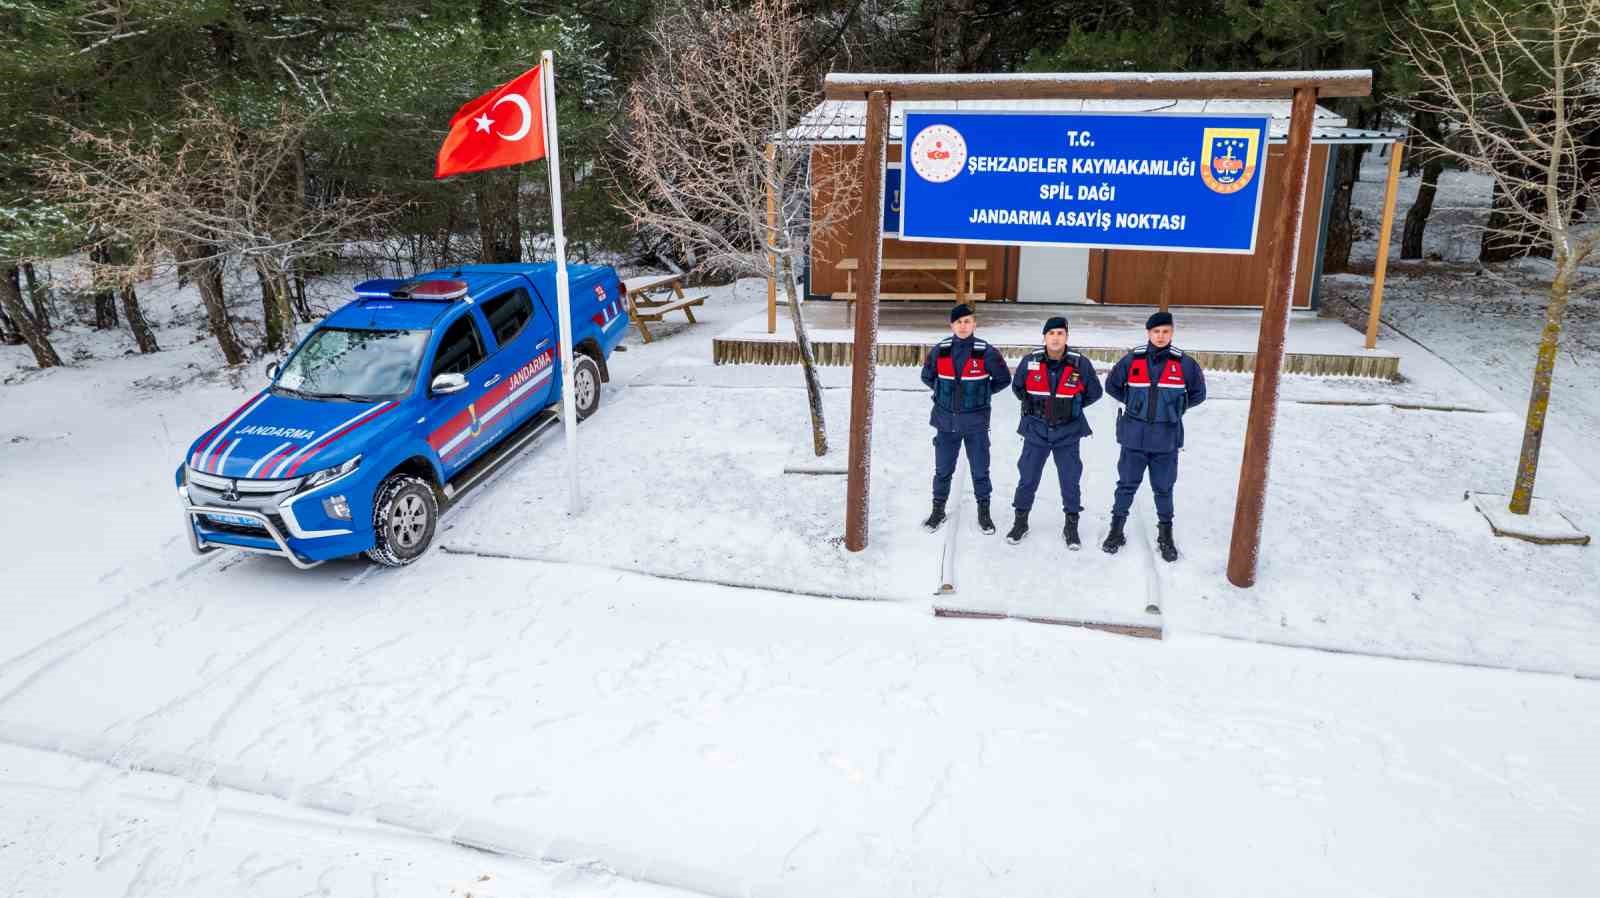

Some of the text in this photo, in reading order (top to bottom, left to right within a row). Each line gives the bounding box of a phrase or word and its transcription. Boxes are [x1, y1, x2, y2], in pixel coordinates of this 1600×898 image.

[1067, 130, 1095, 147] T.C.
[967, 156, 1196, 177] ŞEHZADELER KAYMAKAMLIĞI
[1039, 181, 1116, 201] SPİL DAĞI
[969, 208, 1186, 232] JANDARMA ASAYİŞ NOKTASI
[508, 351, 552, 391] JANDARMA
[235, 424, 316, 440] JANDARMA
